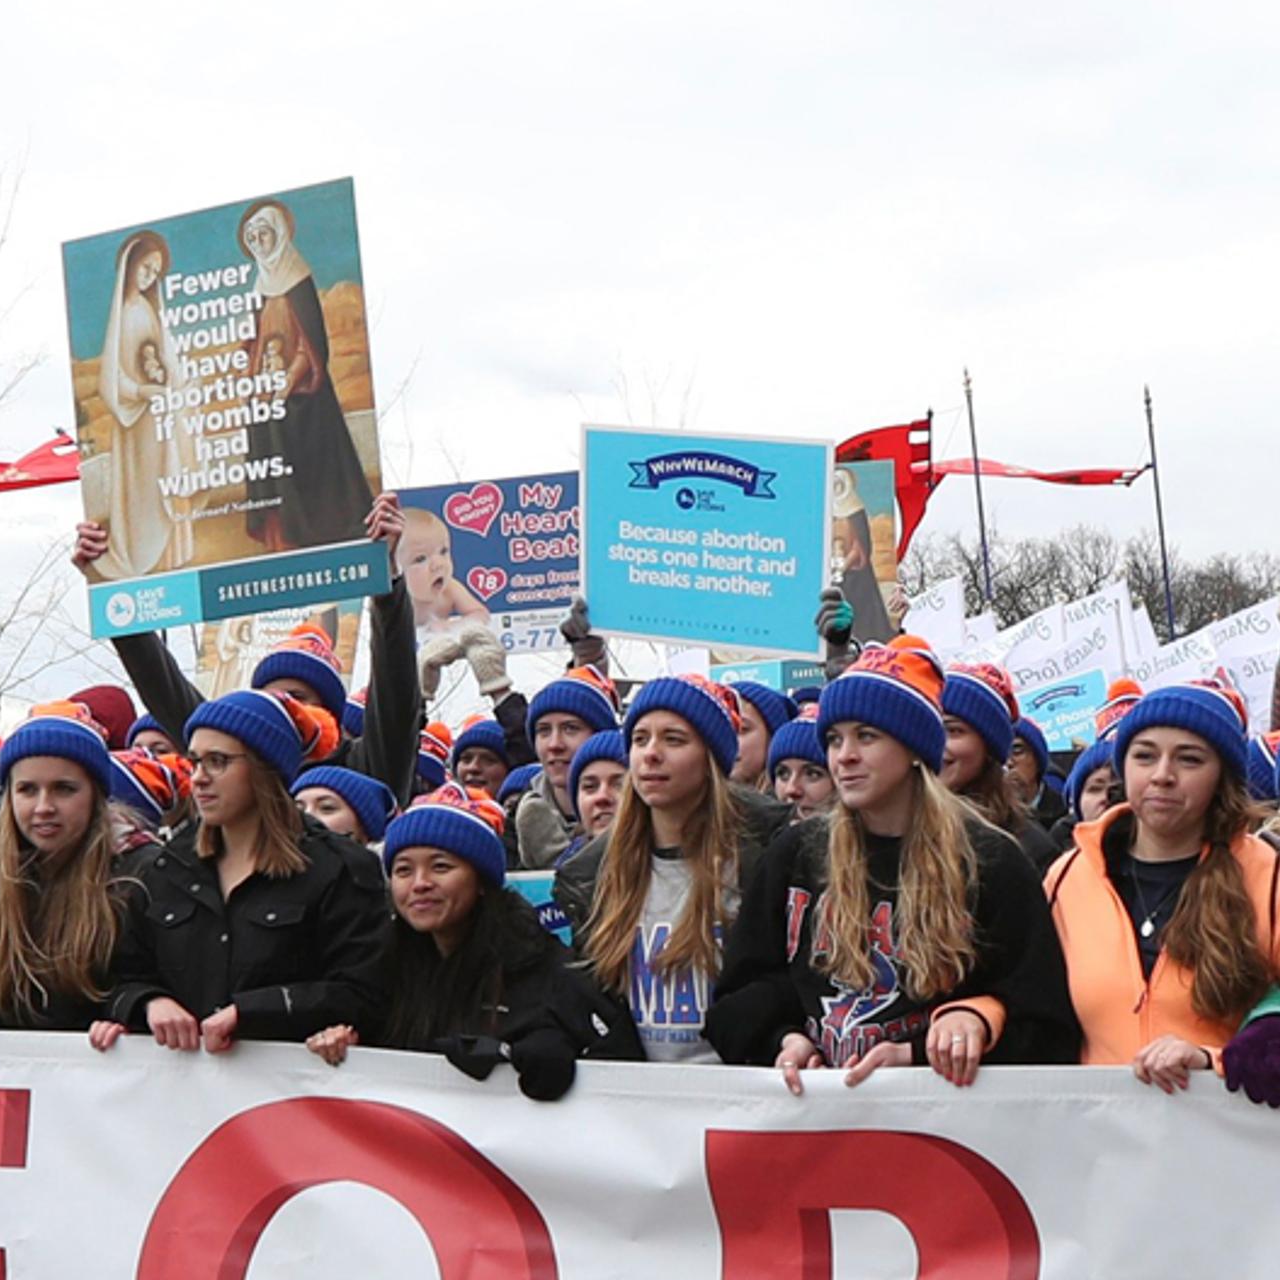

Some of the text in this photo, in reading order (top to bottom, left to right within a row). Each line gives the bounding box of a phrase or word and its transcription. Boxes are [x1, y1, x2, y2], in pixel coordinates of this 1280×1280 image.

[164, 262, 252, 299] Fewer
[160, 290, 263, 328] women
[171, 313, 257, 354] would
[180, 349, 249, 380] have
[149, 370, 287, 415] abortions
[154, 397, 287, 442] if wombs
[194, 428, 250, 462] had
[157, 456, 294, 497] windows.
[518, 482, 563, 509] My
[619, 520, 786, 554] Because abortion
[608, 543, 797, 576] stops one heart and
[218, 564, 370, 602] SAVETHESTORKS.COM
[477, 574, 499, 590] 18
[628, 564, 774, 598] breaks another.
